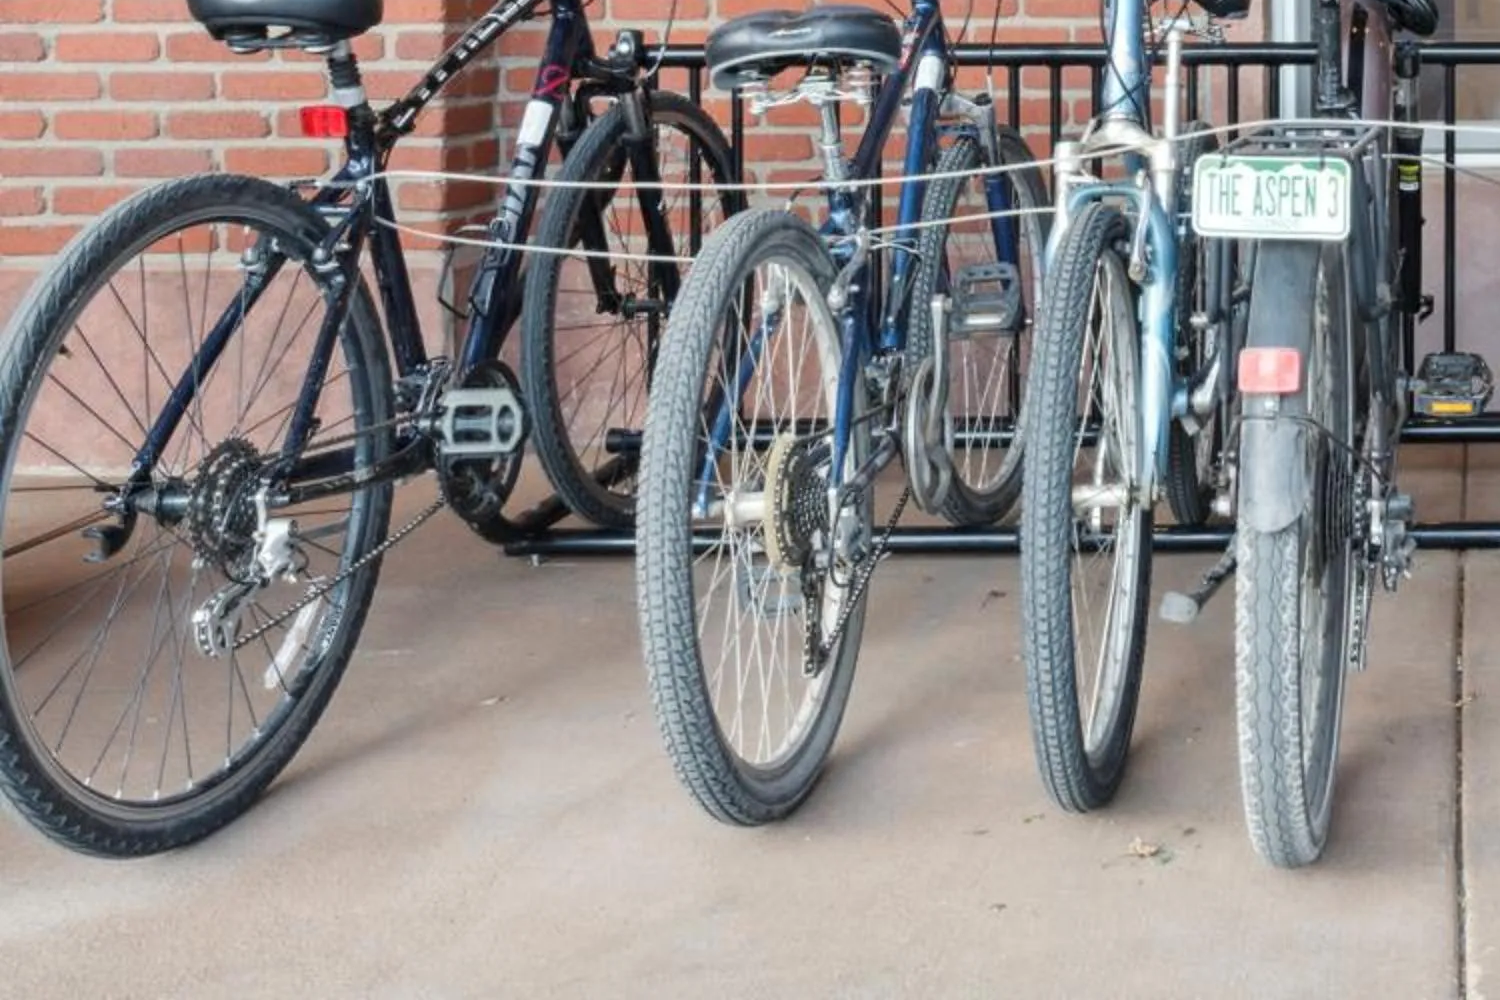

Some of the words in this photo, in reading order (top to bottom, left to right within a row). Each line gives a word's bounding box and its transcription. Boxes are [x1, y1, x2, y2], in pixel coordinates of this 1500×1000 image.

[1207, 172, 1243, 216] THE
[1253, 174, 1318, 218] ASPEN
[1327, 176, 1339, 219] 3
